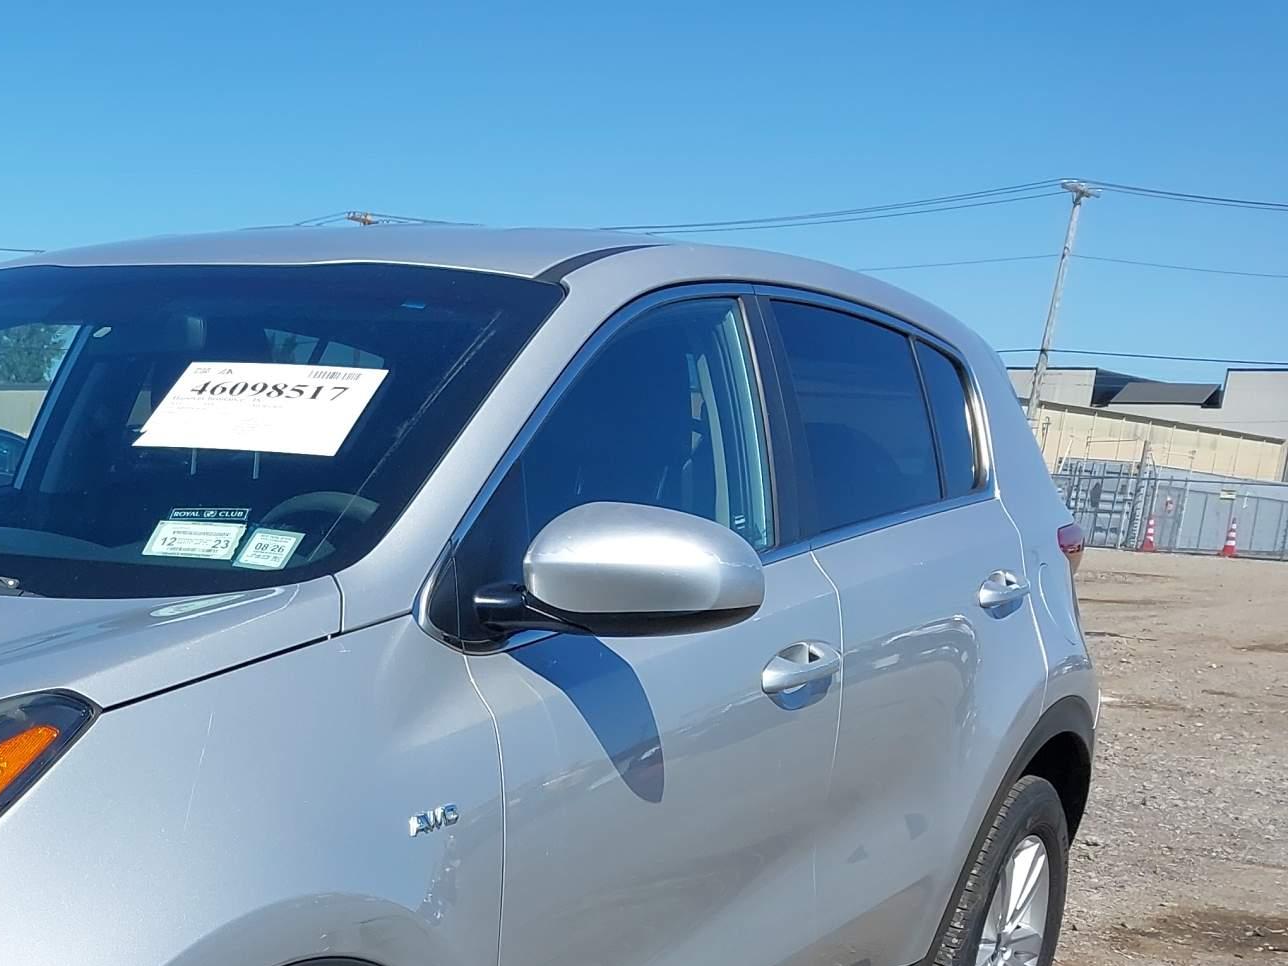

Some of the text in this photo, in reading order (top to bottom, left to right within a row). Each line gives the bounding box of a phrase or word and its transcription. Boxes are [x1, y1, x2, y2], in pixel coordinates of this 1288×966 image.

[190, 380, 350, 402] 46098517
[173, 510, 244, 518] ROYAL CLUB
[160, 536, 177, 547] 12
[212, 539, 232, 550] 23
[254, 542, 270, 552] 08
